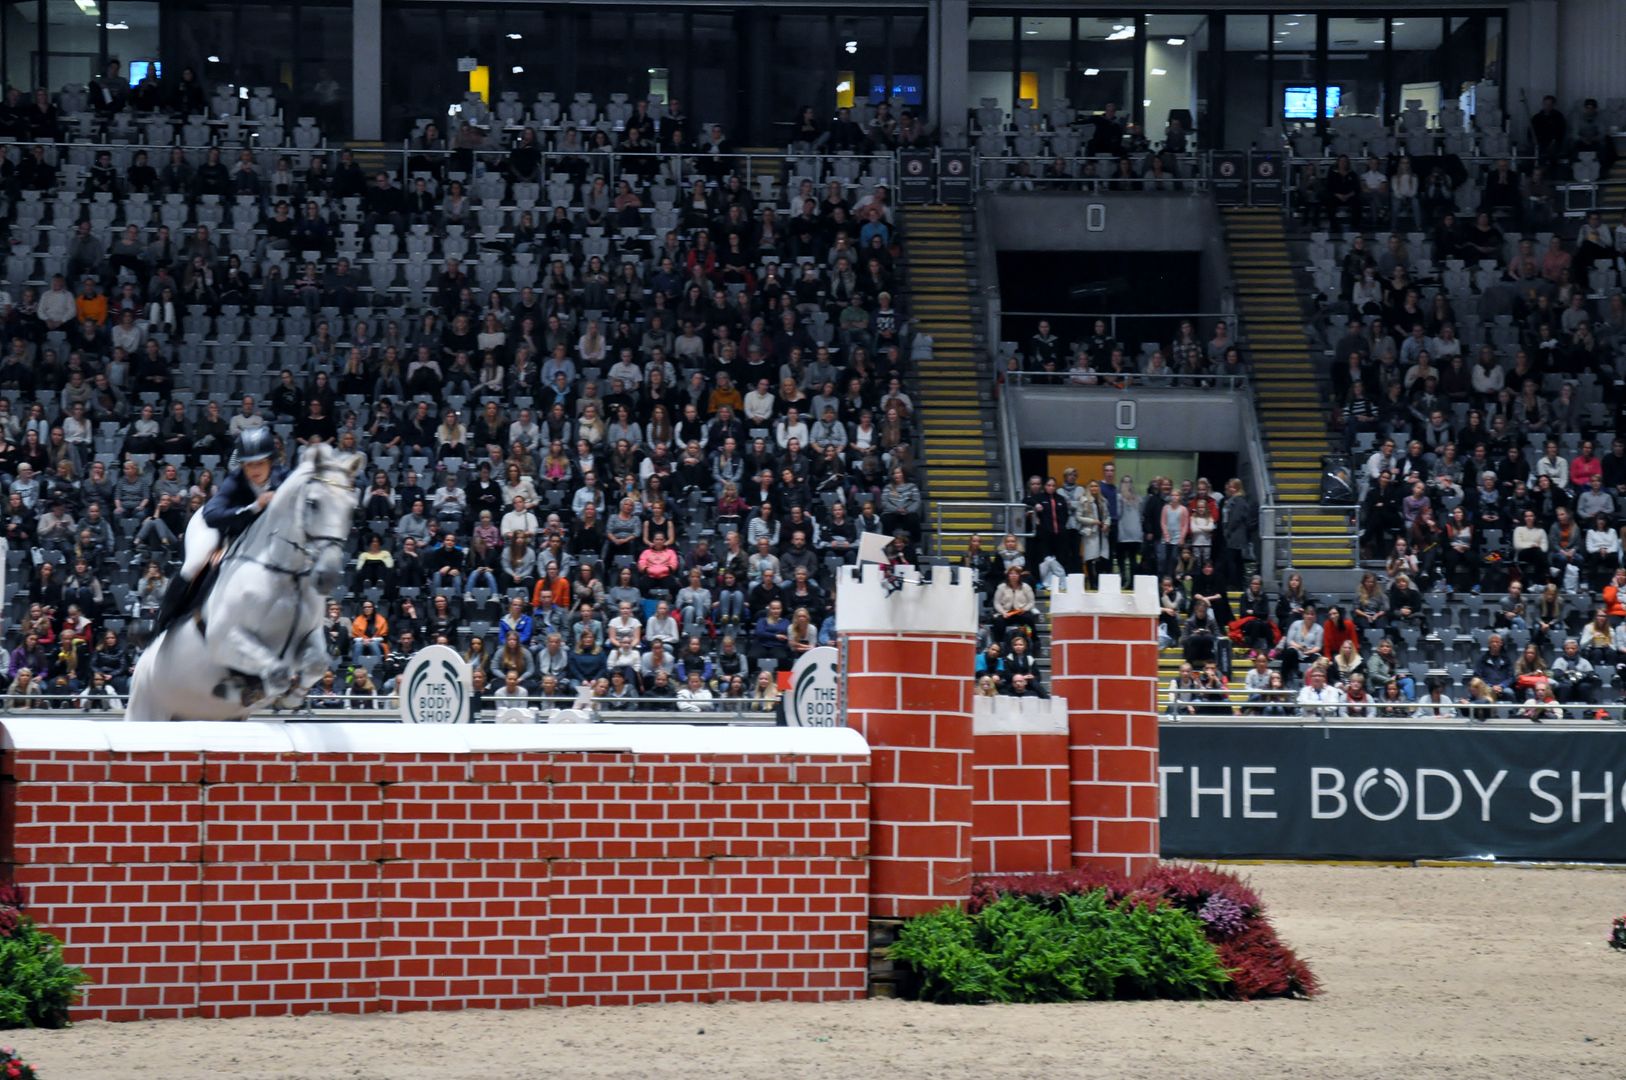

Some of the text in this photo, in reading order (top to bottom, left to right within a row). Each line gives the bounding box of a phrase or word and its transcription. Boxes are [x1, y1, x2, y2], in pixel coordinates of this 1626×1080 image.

[426, 683, 447, 695] THE
[814, 688, 836, 701] THE
[420, 697, 452, 709] BODY
[807, 702, 837, 715] BOD
[420, 711, 451, 723] SHOP
[1158, 766, 1626, 824] THE BODY SH
